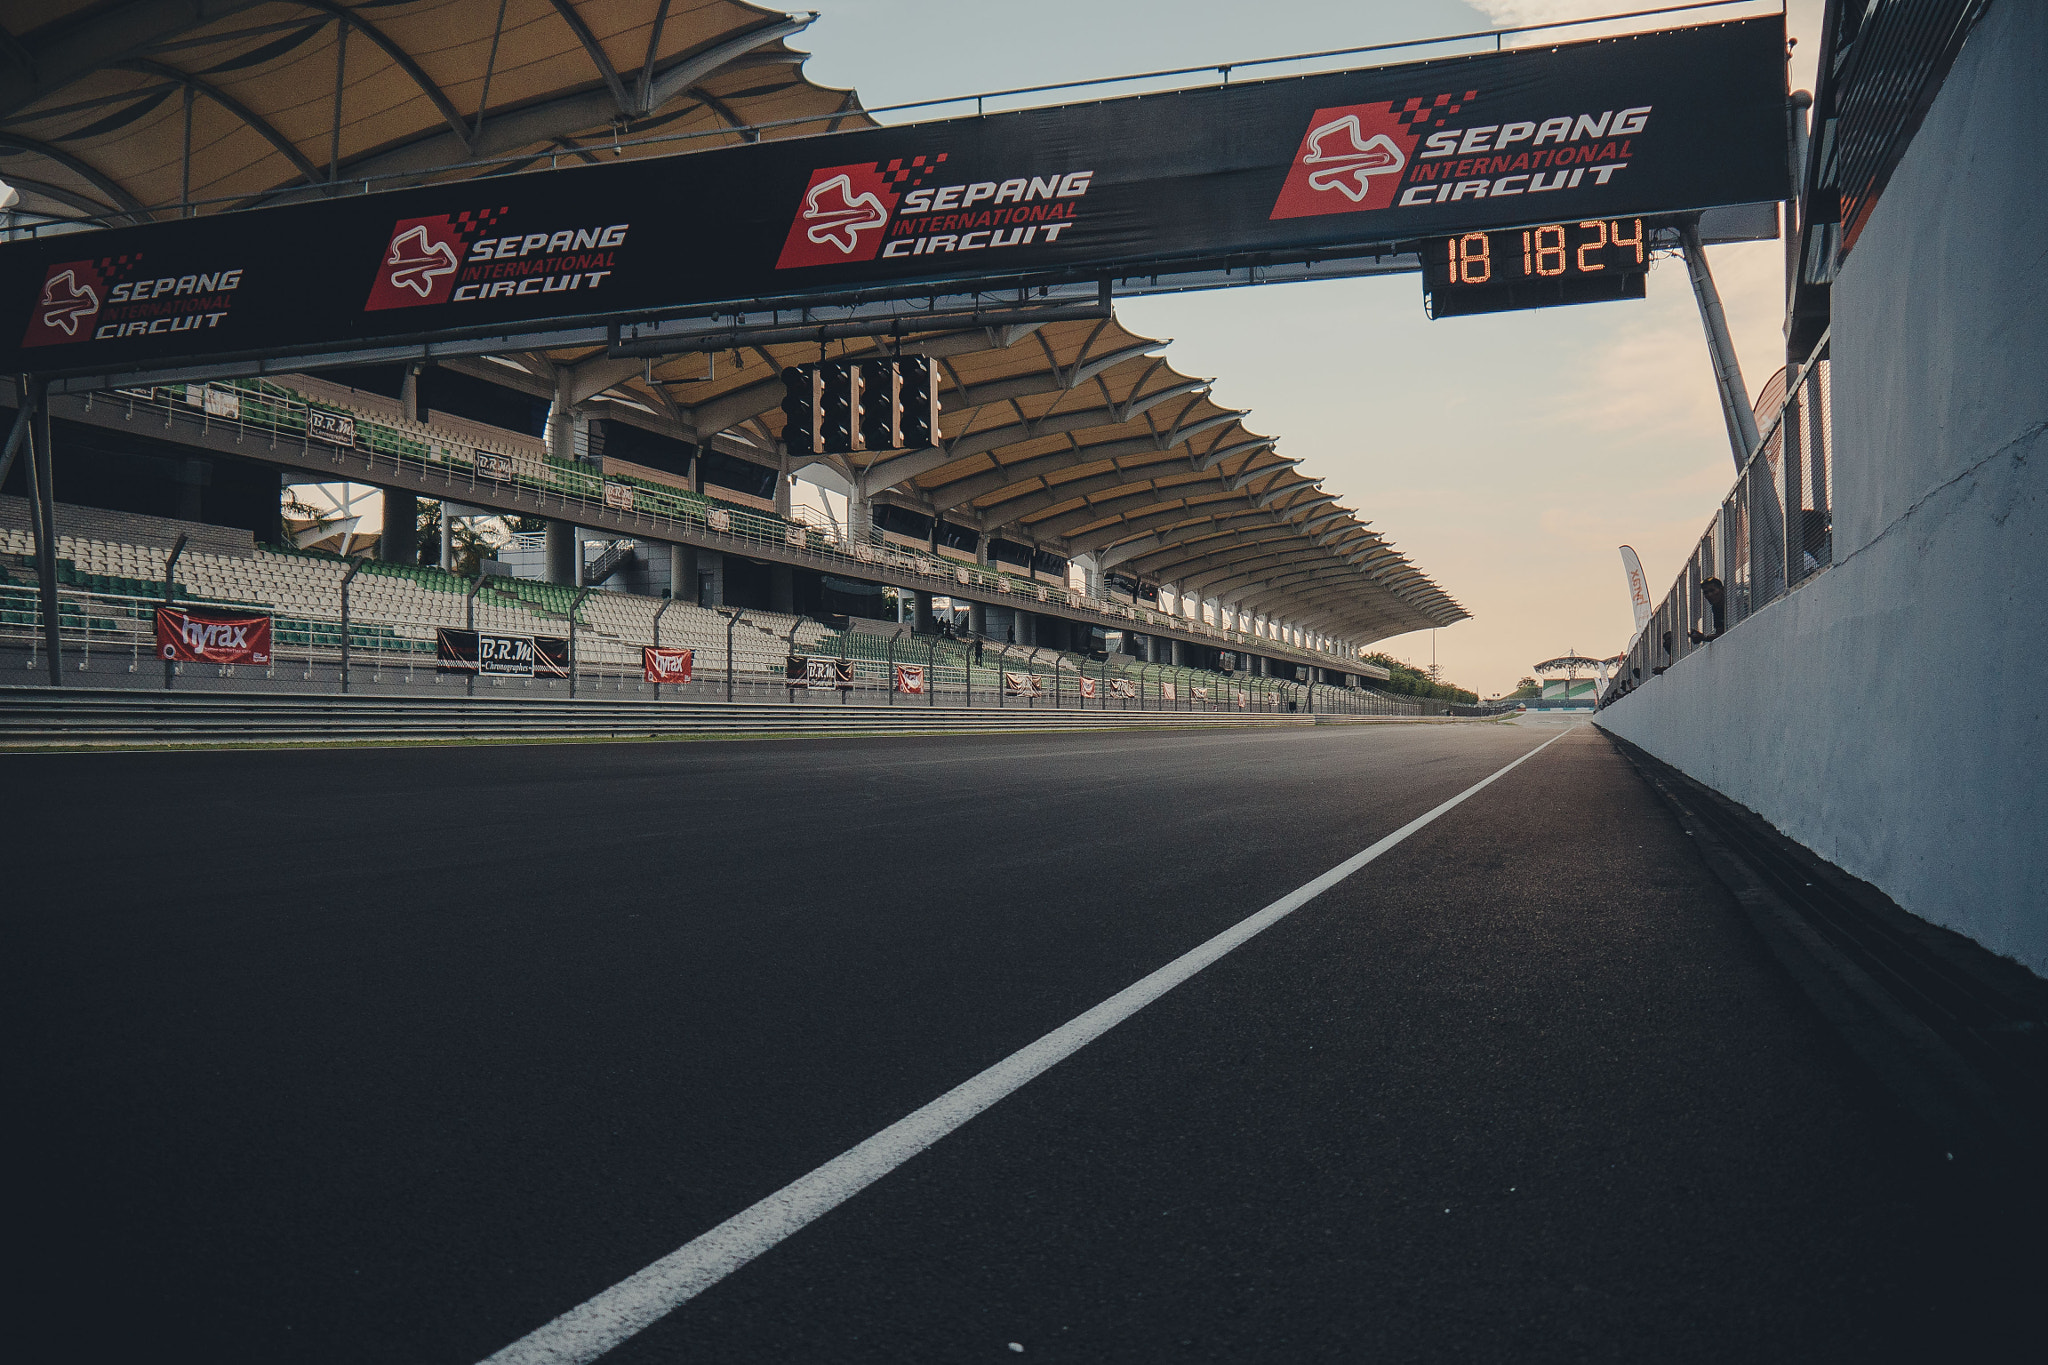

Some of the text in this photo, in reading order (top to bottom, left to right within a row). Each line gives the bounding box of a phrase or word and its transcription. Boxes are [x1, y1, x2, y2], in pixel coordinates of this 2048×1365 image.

[1420, 105, 1652, 159] SEPANG
[1410, 140, 1634, 182] INTERNATIONAL
[900, 170, 1094, 215] SEPANG
[1398, 162, 1628, 207] CIRCUIT
[891, 202, 1078, 237] INTERNATIONAL
[468, 223, 630, 262] SEPANG
[882, 222, 1073, 258] CIRCUIT
[1448, 218, 1644, 284] 18 18 24
[461, 251, 616, 282] INTERNATIONAL
[108, 268, 244, 303] SEPANG
[453, 270, 612, 302] CIRCUIT
[102, 294, 232, 321] INTERNATIONAL
[95, 311, 228, 340] CIRCUIT
[182, 614, 247, 654] hyrax
[481, 638, 532, 661] B.R.M
[655, 649, 683, 678] hyrax
